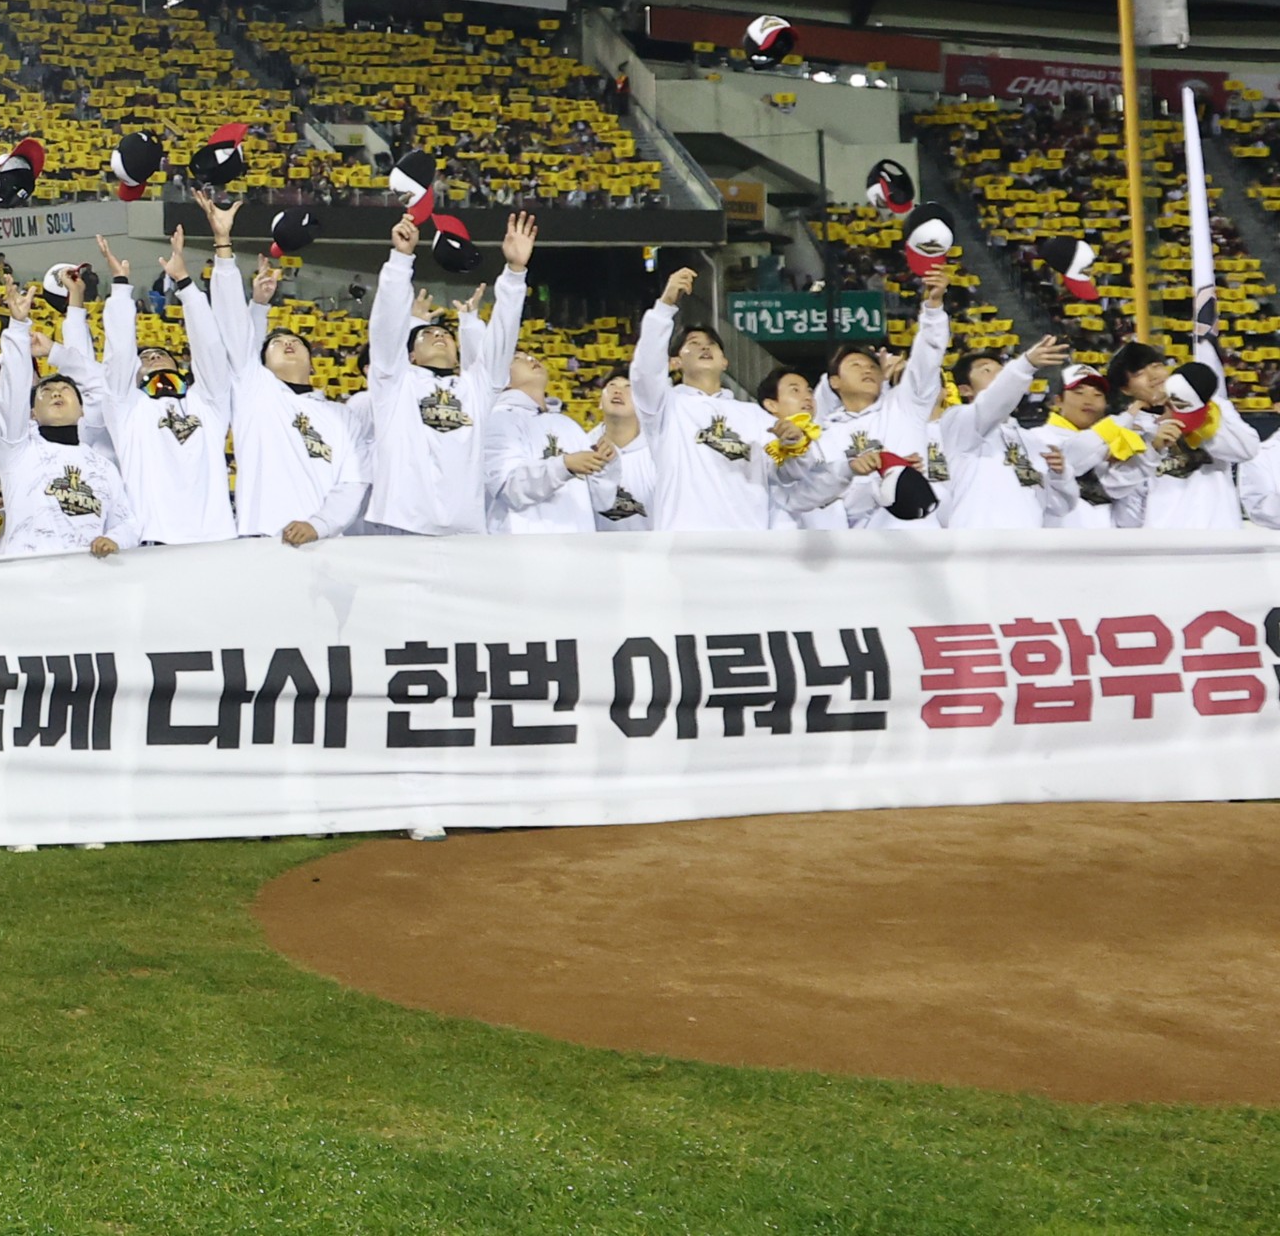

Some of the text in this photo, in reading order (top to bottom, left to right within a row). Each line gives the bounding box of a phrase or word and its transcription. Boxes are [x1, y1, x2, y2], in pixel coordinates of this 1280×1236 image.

[1043, 65, 1069, 78] THE
[1071, 68, 1107, 81] ROAD
[146, 646, 353, 749] 다시
[384, 639, 580, 748] 한번
[610, 628, 891, 740] 이뤄낸
[909, 607, 1280, 728] 통합우승
